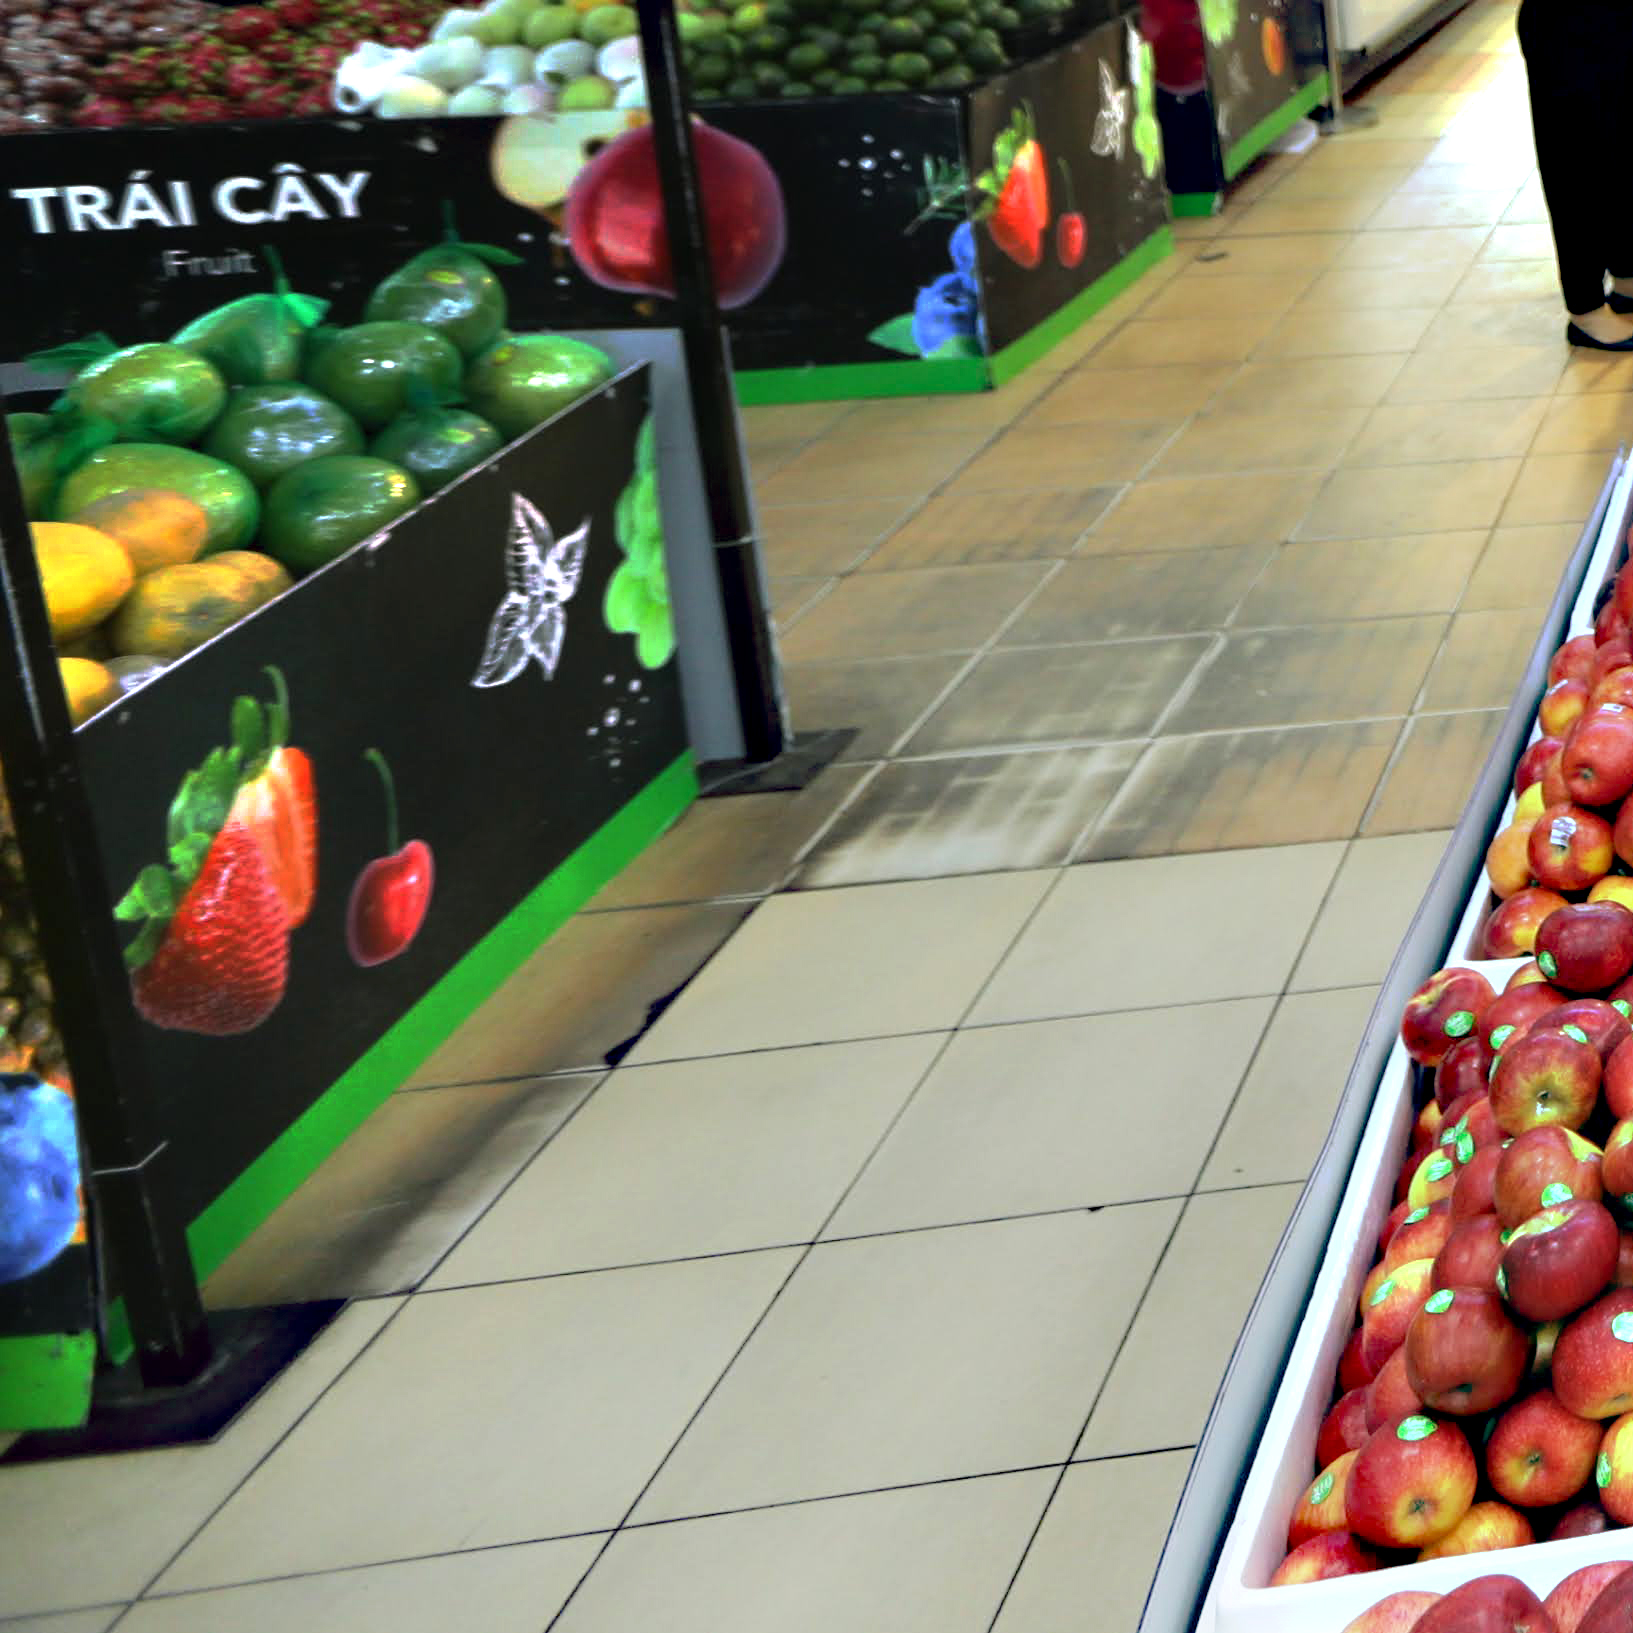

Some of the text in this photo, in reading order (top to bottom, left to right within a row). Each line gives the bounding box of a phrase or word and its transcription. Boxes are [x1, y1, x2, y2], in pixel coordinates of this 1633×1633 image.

[12, 163, 370, 235] TRÁI CÂY
[162, 248, 256, 279] Fruit
